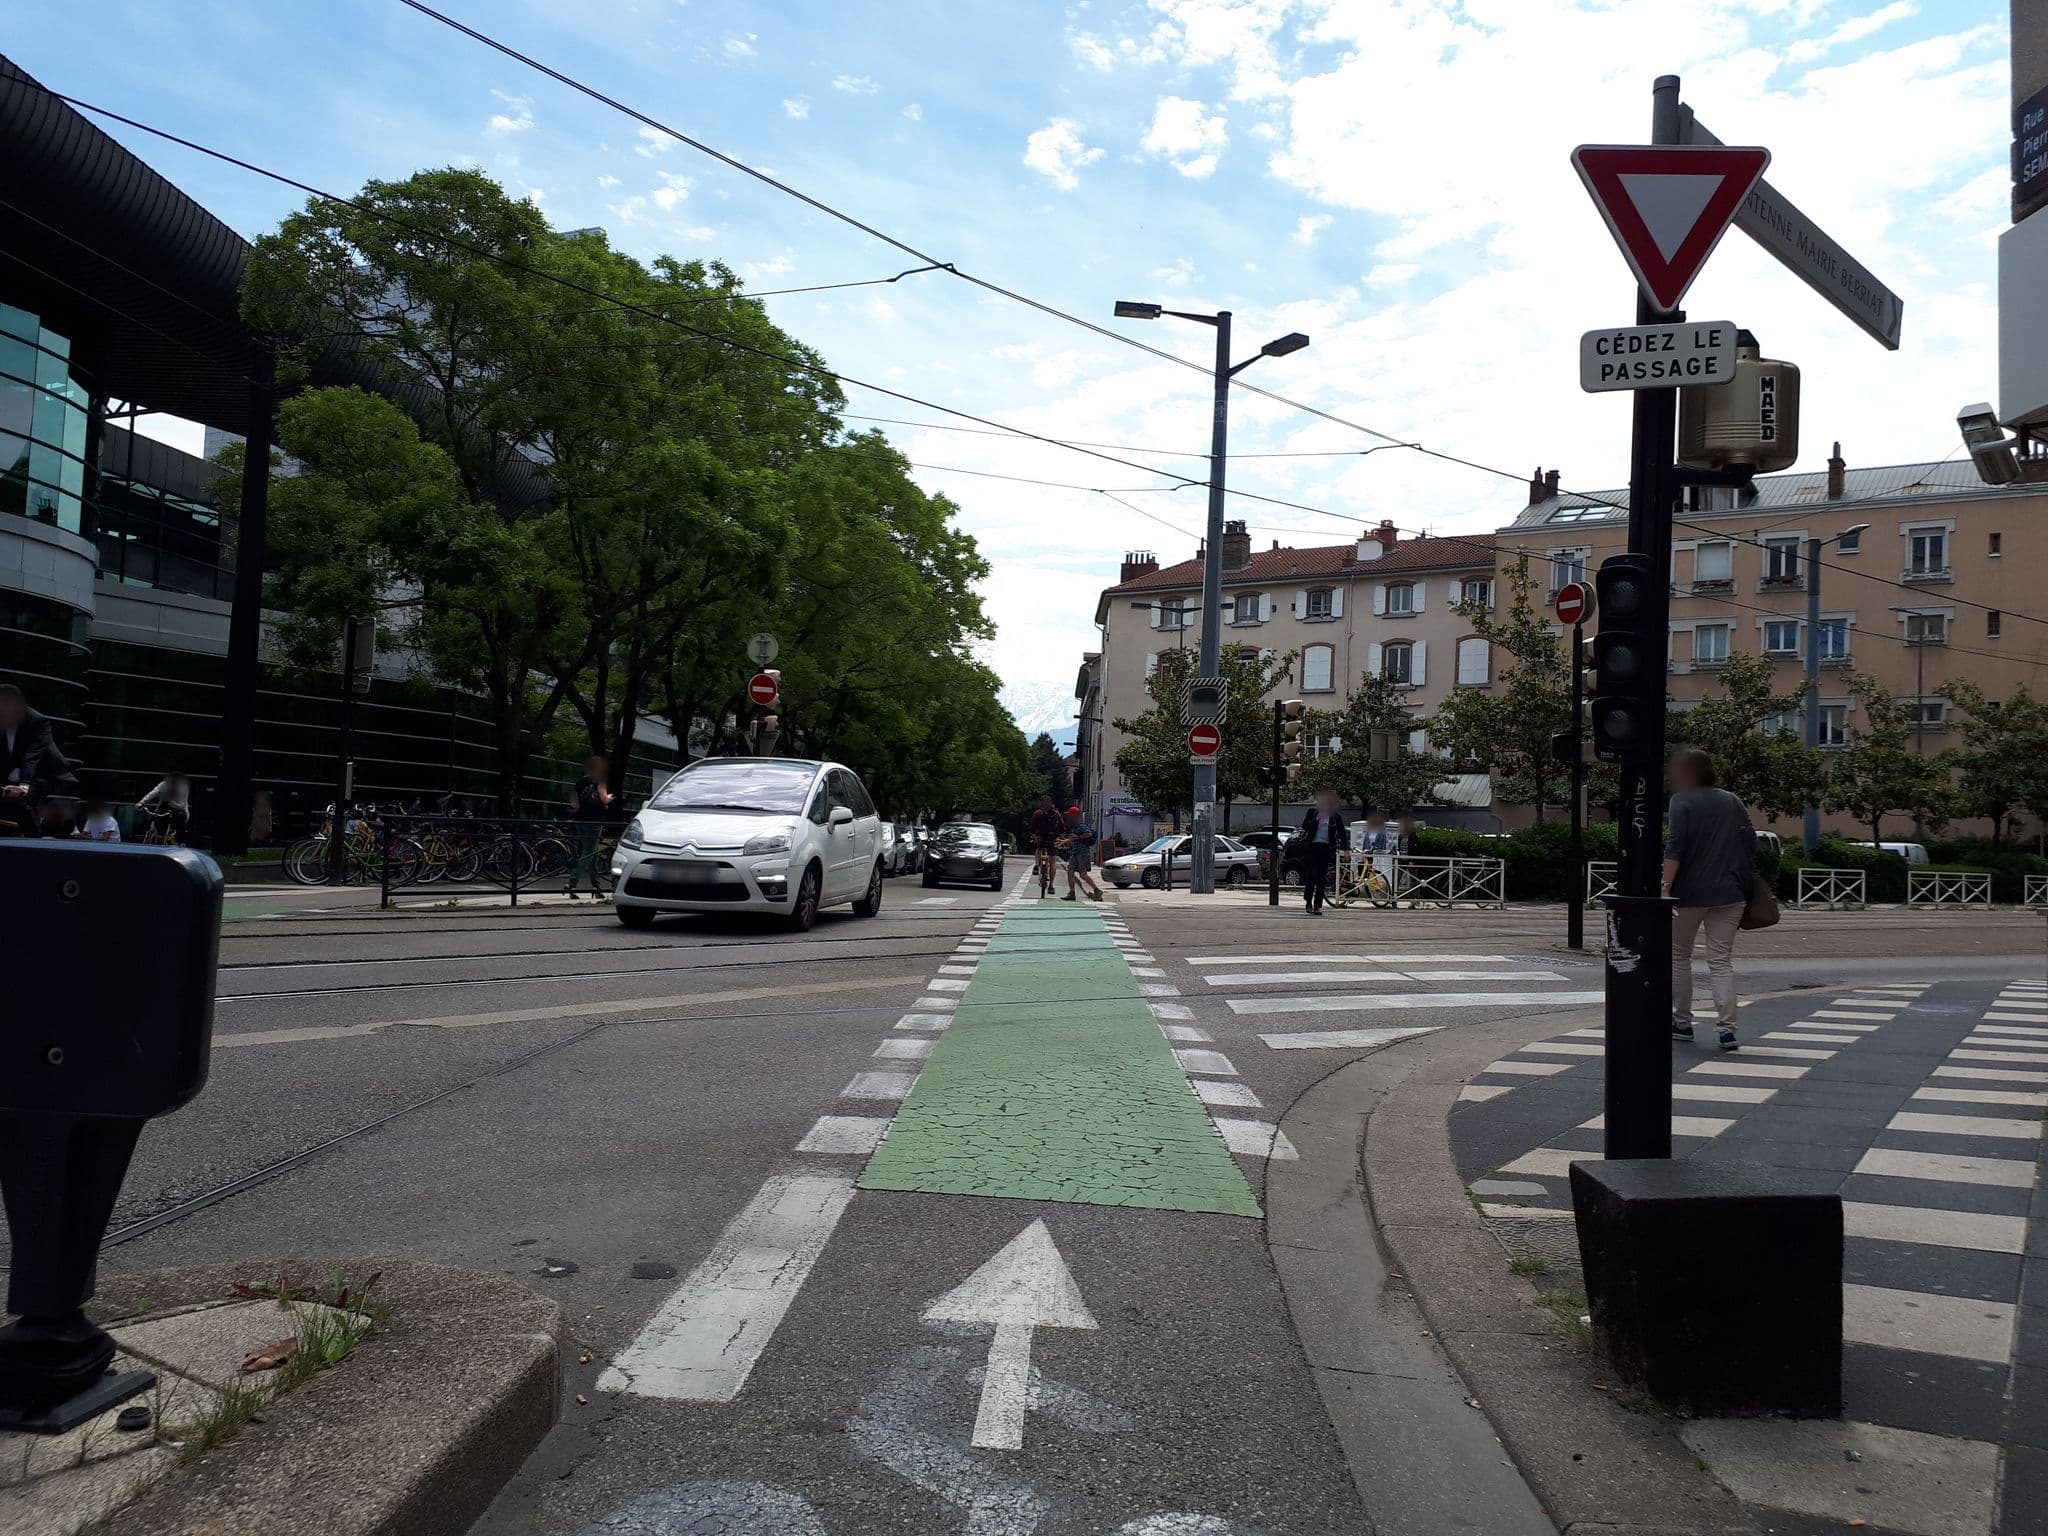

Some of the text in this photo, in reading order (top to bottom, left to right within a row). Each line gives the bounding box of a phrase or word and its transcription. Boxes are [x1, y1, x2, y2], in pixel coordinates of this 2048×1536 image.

[2023, 108, 2044, 133] Rue
[2023, 129, 2048, 158] Pierr
[2023, 151, 2048, 183] SEM
[1744, 191, 1883, 318] NTENNE MAIRIE BERRIAT
[1596, 329, 1722, 356] CÉDEZ LE
[1601, 356, 1717, 381] PASSAGE
[1760, 376, 1775, 441] MAED
